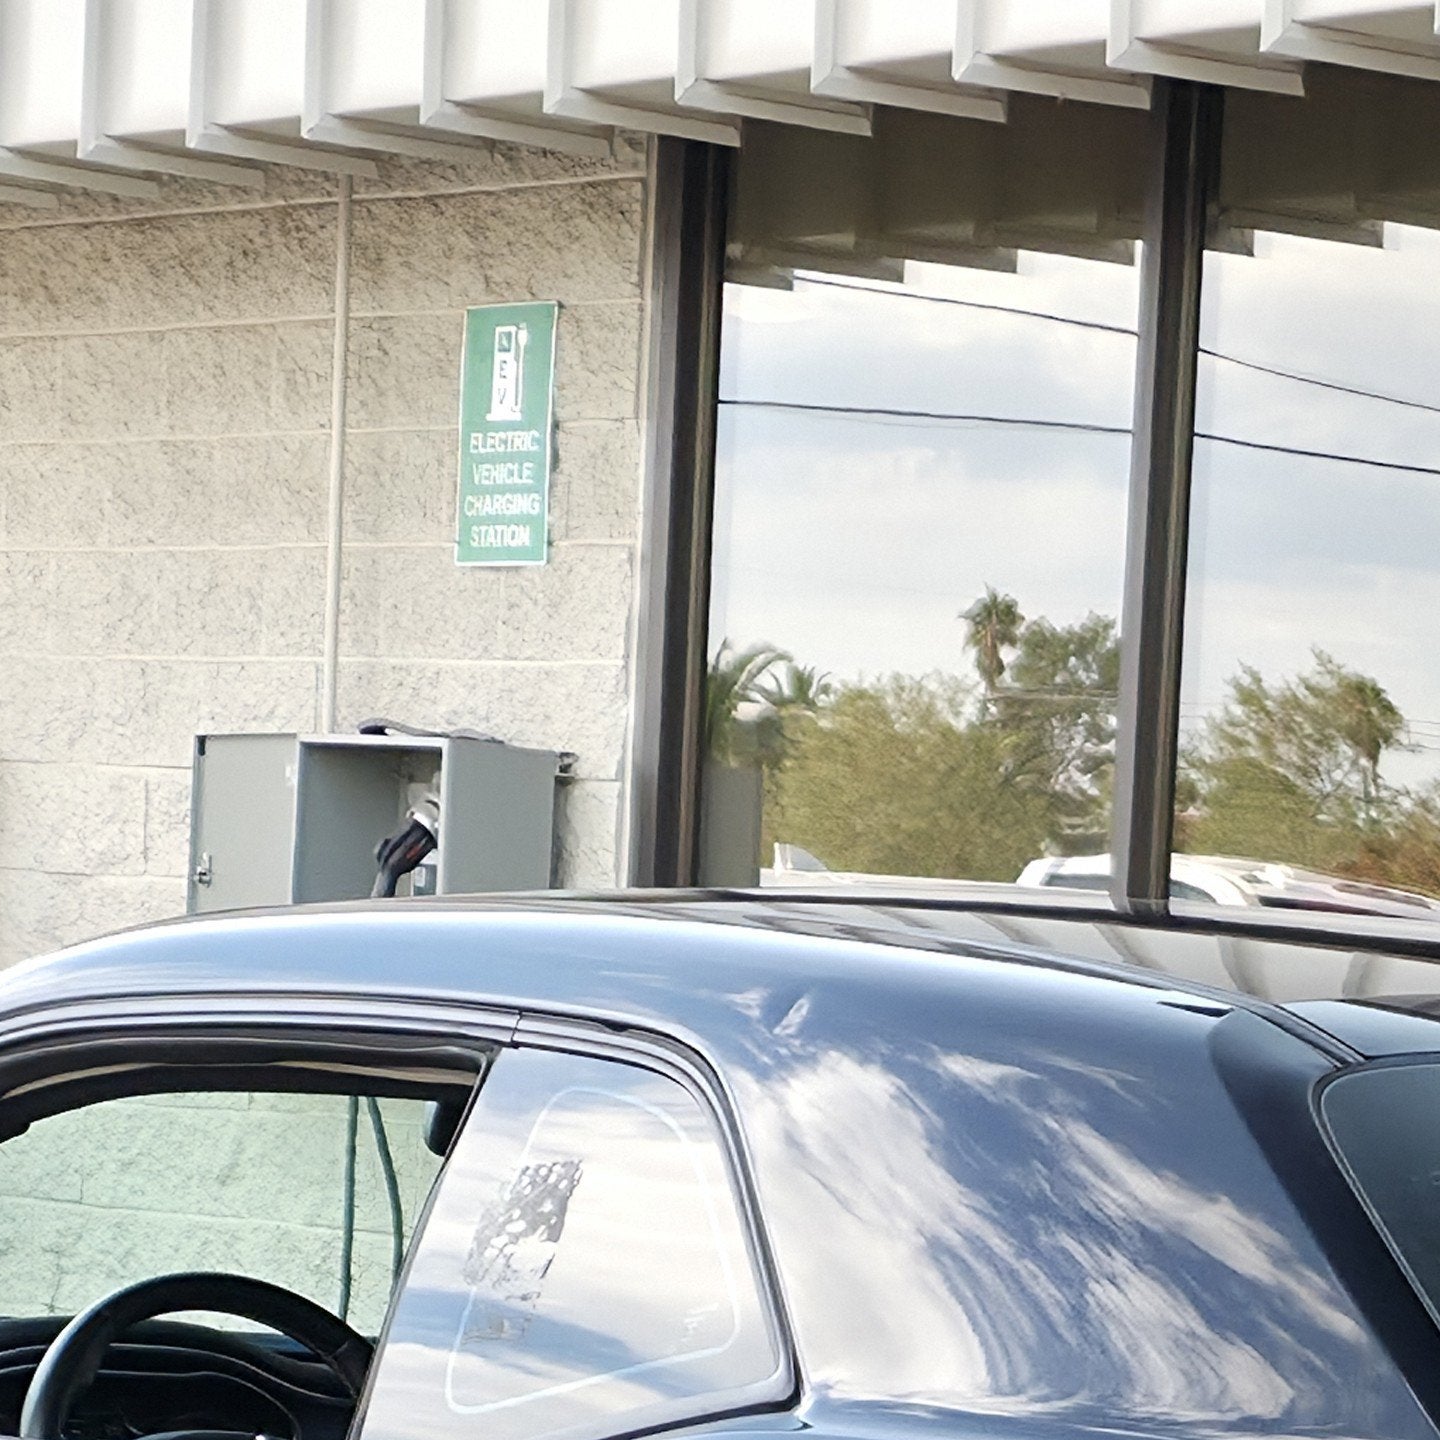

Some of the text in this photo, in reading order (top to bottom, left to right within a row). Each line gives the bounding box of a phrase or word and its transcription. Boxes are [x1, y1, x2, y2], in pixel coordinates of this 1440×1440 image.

[470, 431, 540, 453] ELECTRIC
[472, 463, 534, 485] VEHICLE
[464, 493, 541, 517] CHARGING
[470, 525, 531, 547] STATION
